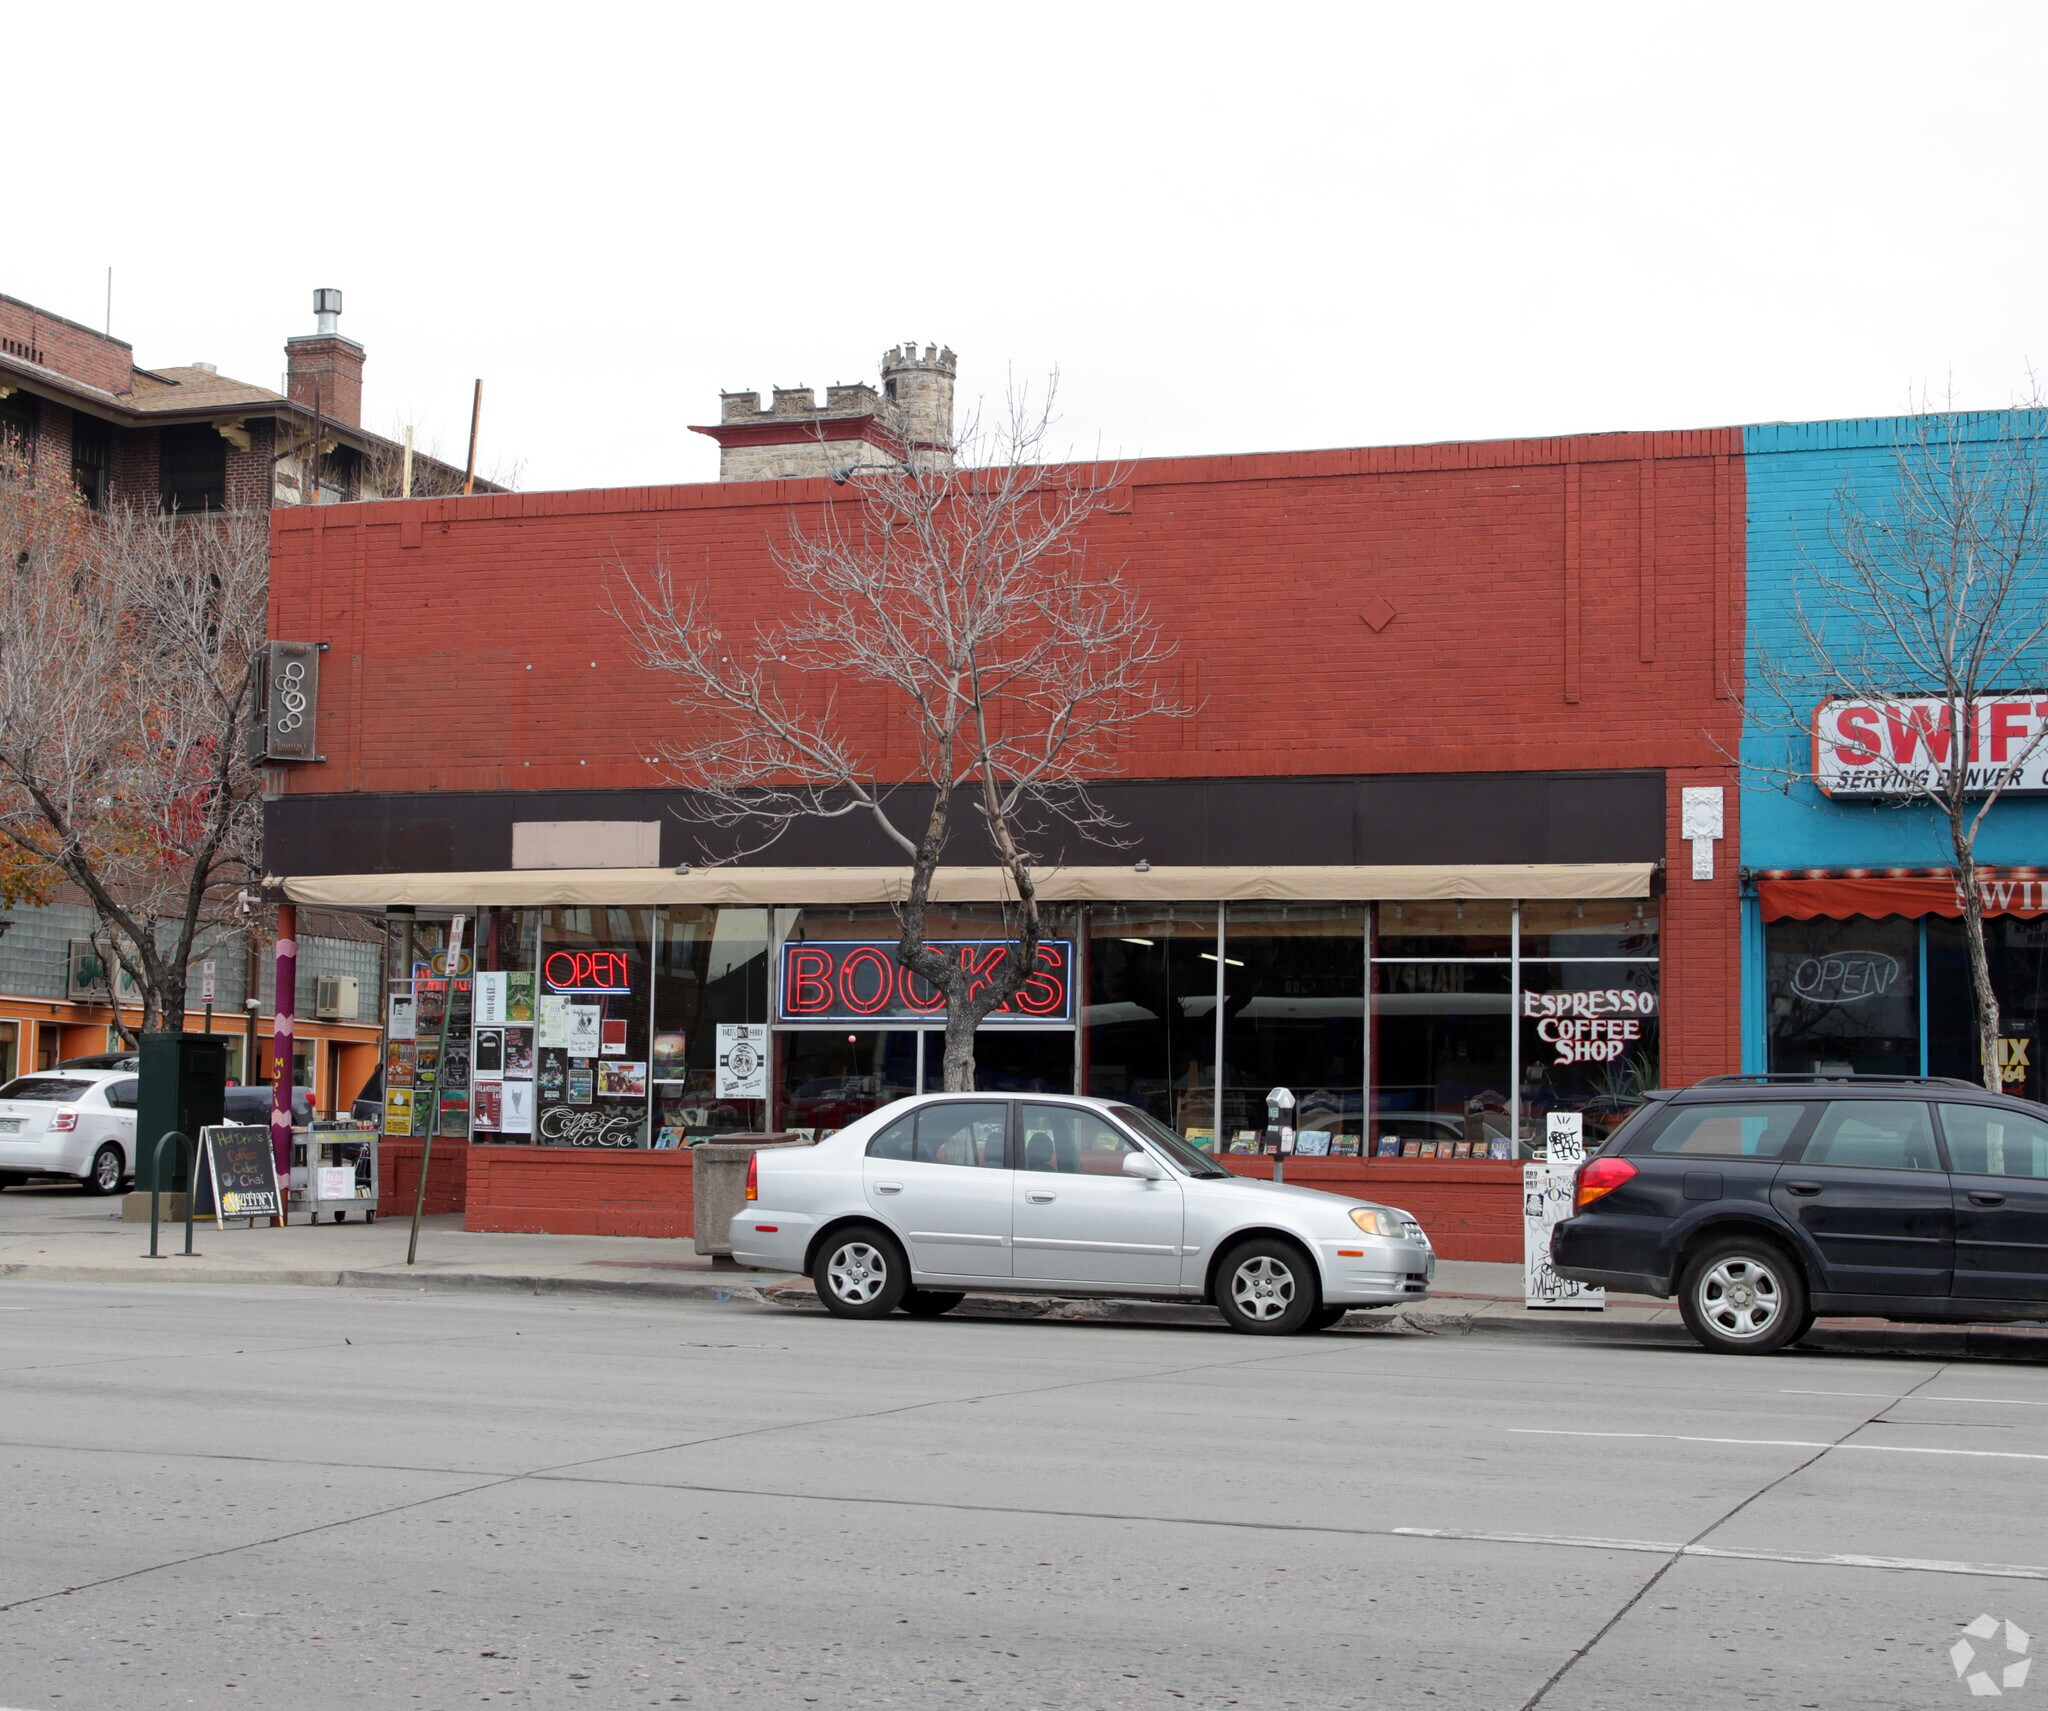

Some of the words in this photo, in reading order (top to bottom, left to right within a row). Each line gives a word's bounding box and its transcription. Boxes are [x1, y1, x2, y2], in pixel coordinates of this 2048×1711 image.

[1835, 702, 2048, 766] SWIF
[1836, 768, 1930, 789] SERVING
[1936, 767, 2024, 787] DNVER
[545, 952, 629, 987] OPEN
[1794, 957, 1889, 994] OPEN
[1523, 989, 1654, 1018] ESPRESSO
[1536, 1017, 1641, 1042] COFFEE
[1553, 1040, 1624, 1066] SHOP
[1981, 1038, 2030, 1066] IX
[541, 1106, 601, 1140] Coffee
[573, 1127, 598, 1146] to
[598, 1117, 635, 1147] Go
[216, 1132, 233, 1147] Hot
[226, 1149, 257, 1163] Coffee
[232, 1161, 259, 1174] Cider
[239, 1174, 265, 1187] Chai
[223, 1191, 276, 1212] MUTINY
